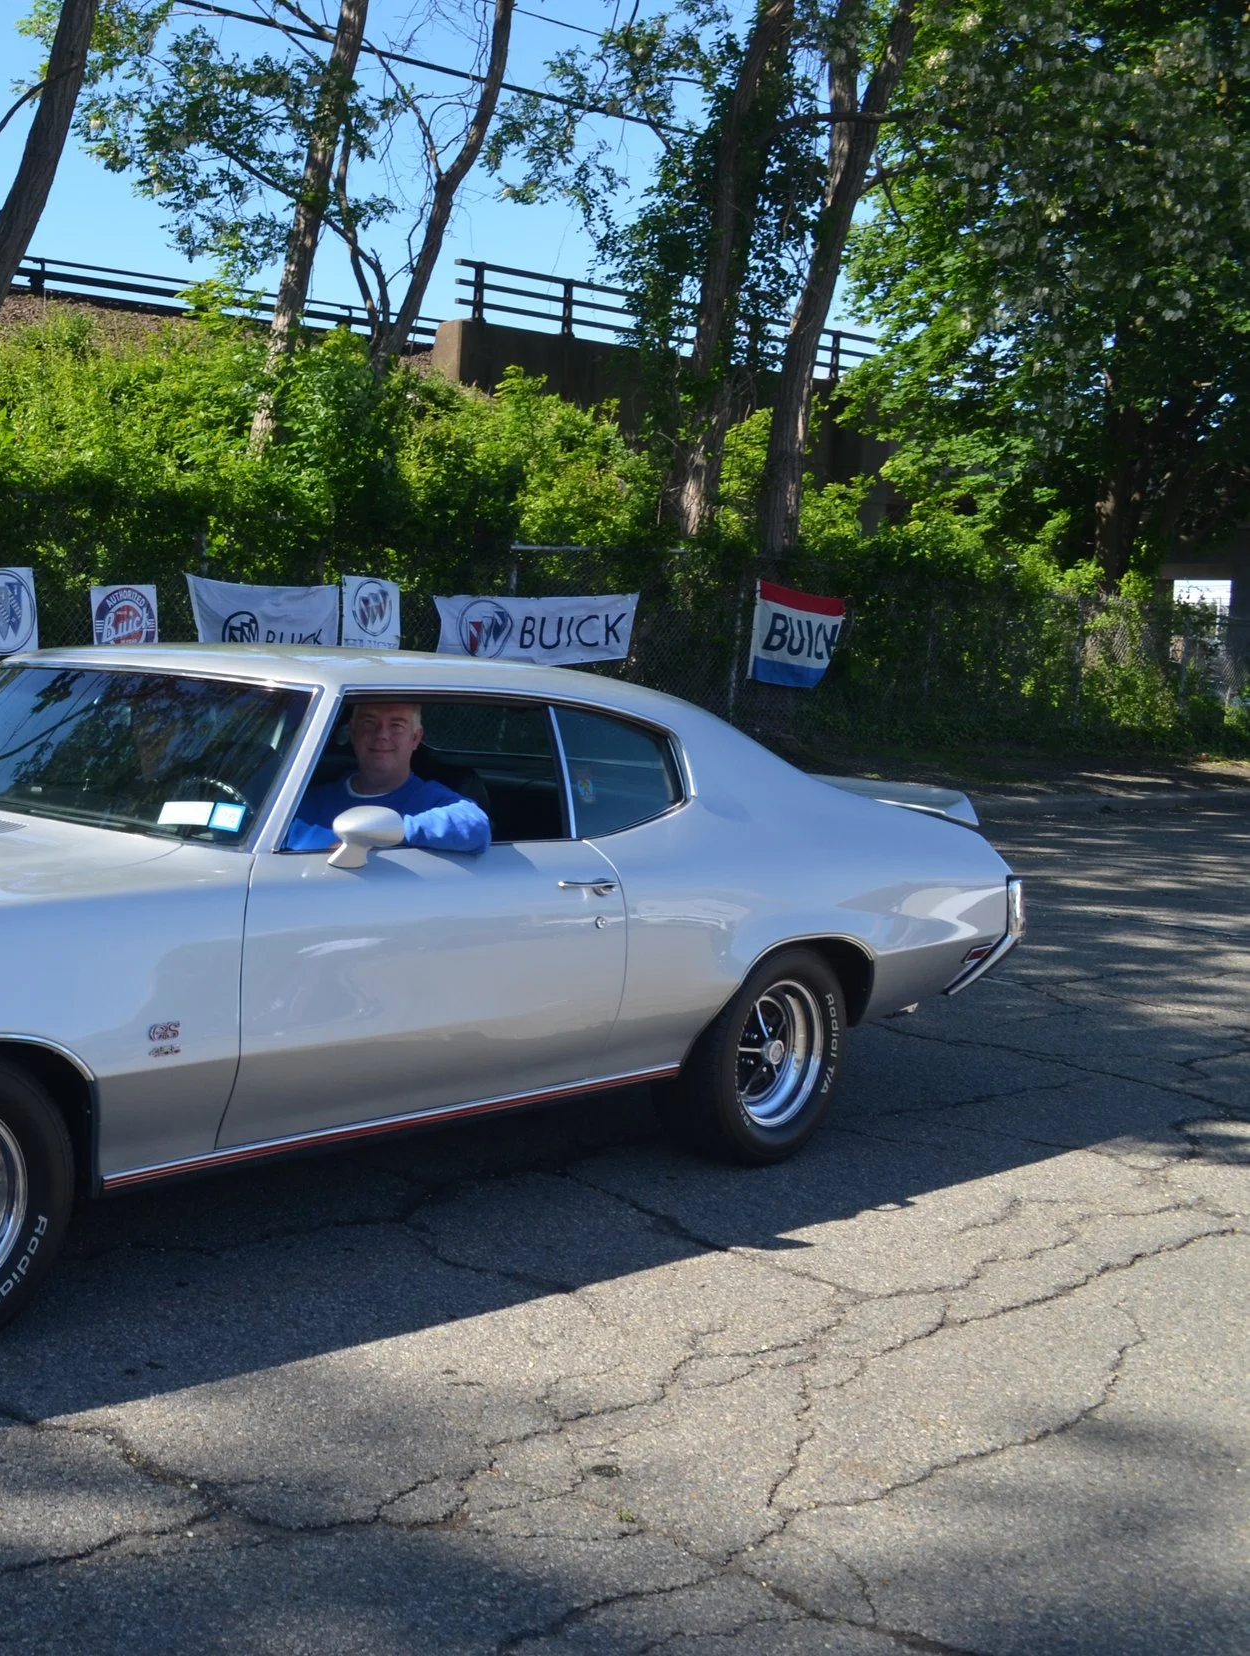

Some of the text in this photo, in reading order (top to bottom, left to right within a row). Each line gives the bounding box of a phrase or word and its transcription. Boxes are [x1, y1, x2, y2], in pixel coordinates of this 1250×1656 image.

[519, 612, 627, 650] BUICK
[149, 1021, 180, 1041] GS
[820, 993, 840, 1094] Radial T/A
